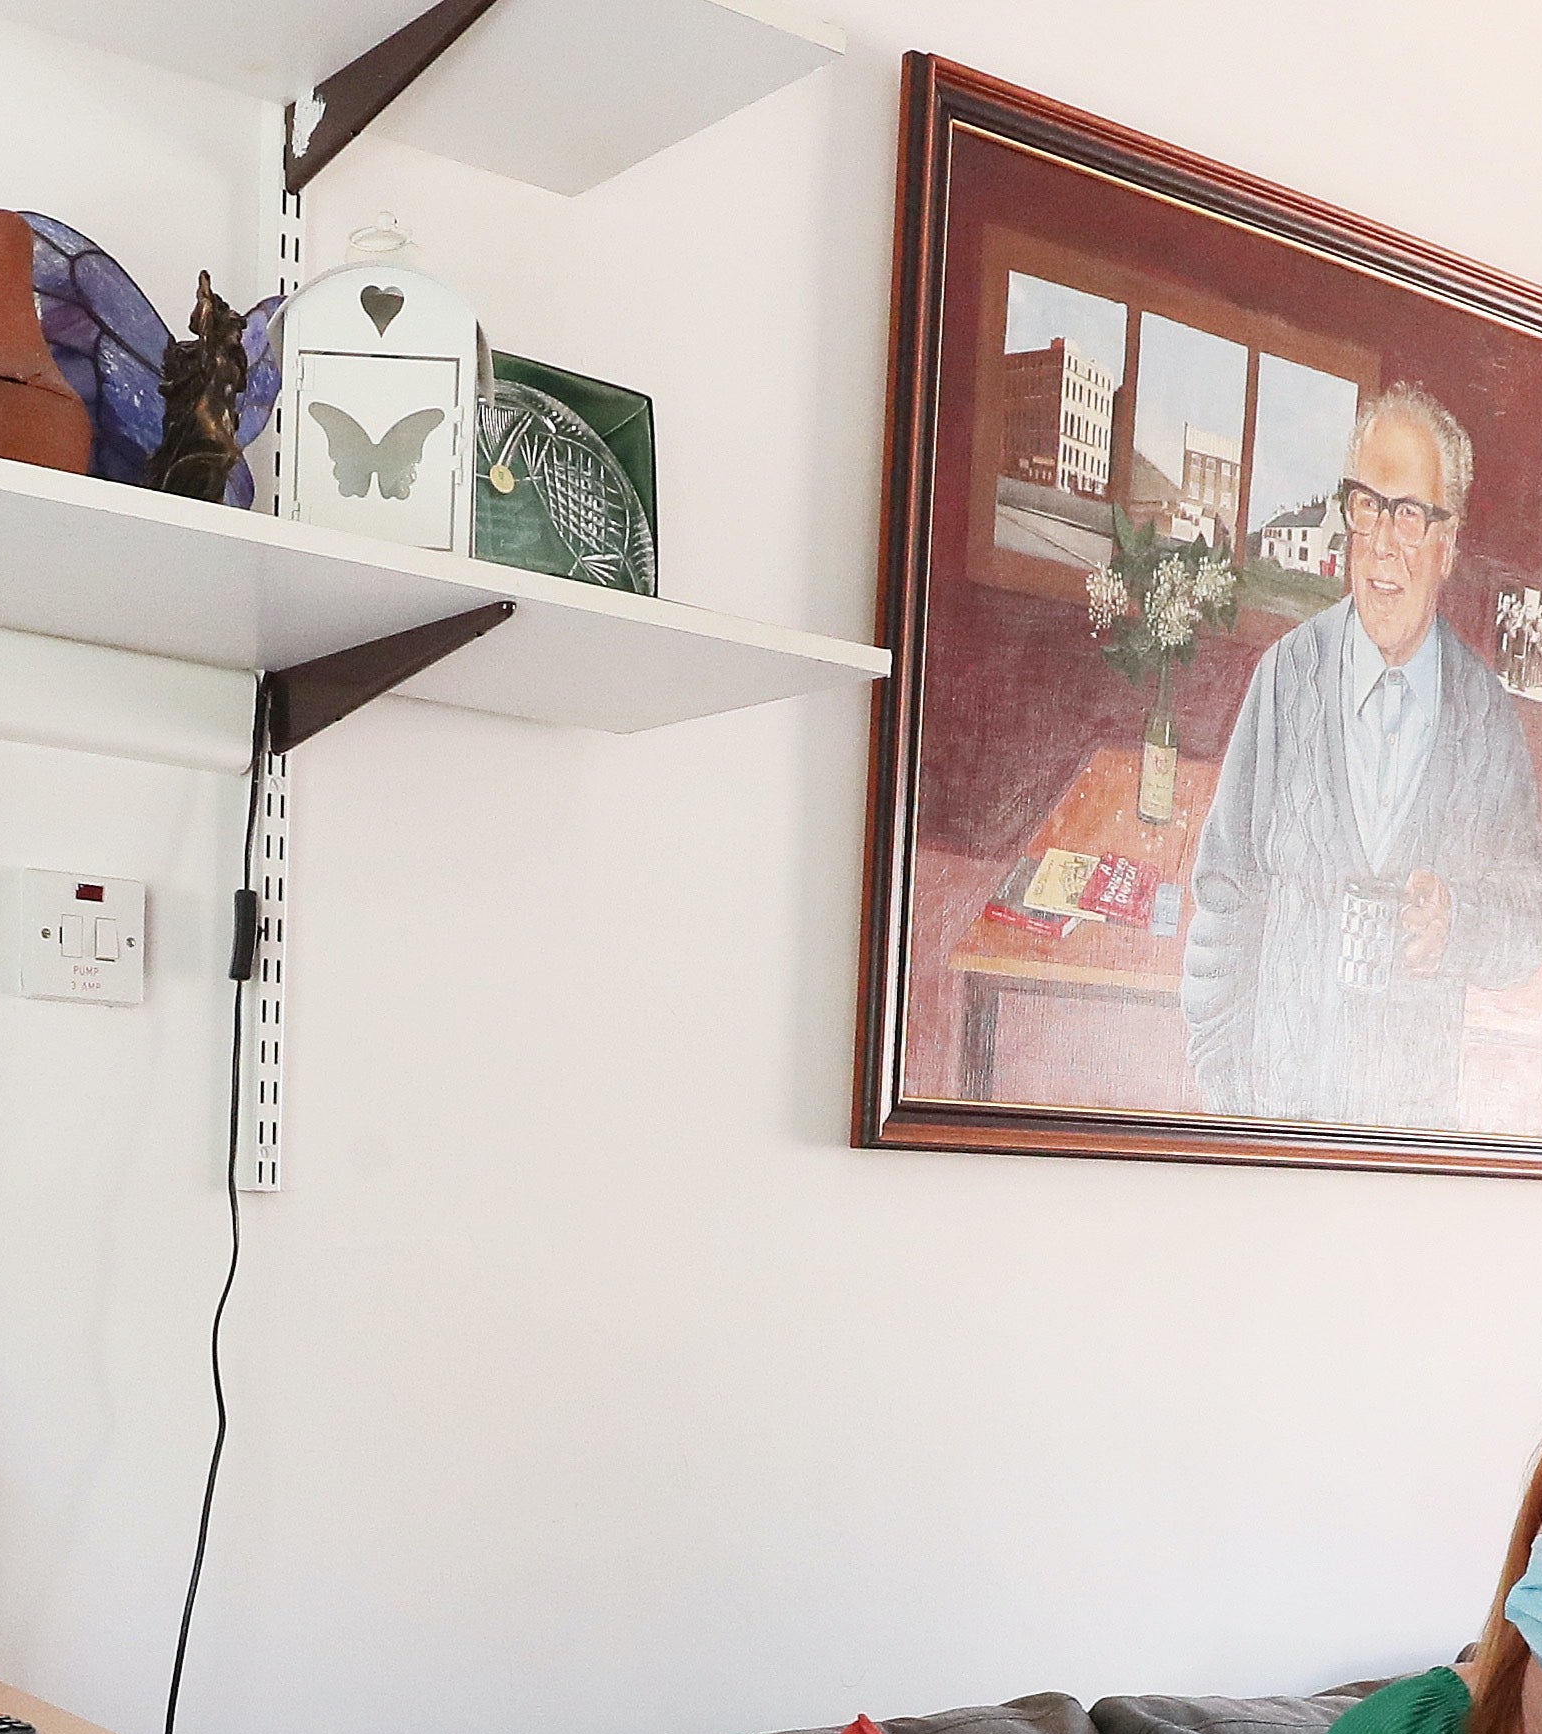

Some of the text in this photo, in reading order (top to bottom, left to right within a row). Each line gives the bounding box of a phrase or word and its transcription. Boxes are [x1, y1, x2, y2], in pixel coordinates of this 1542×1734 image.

[73, 965, 99, 976] PUMP
[71, 980, 101, 991] 3 AMP
